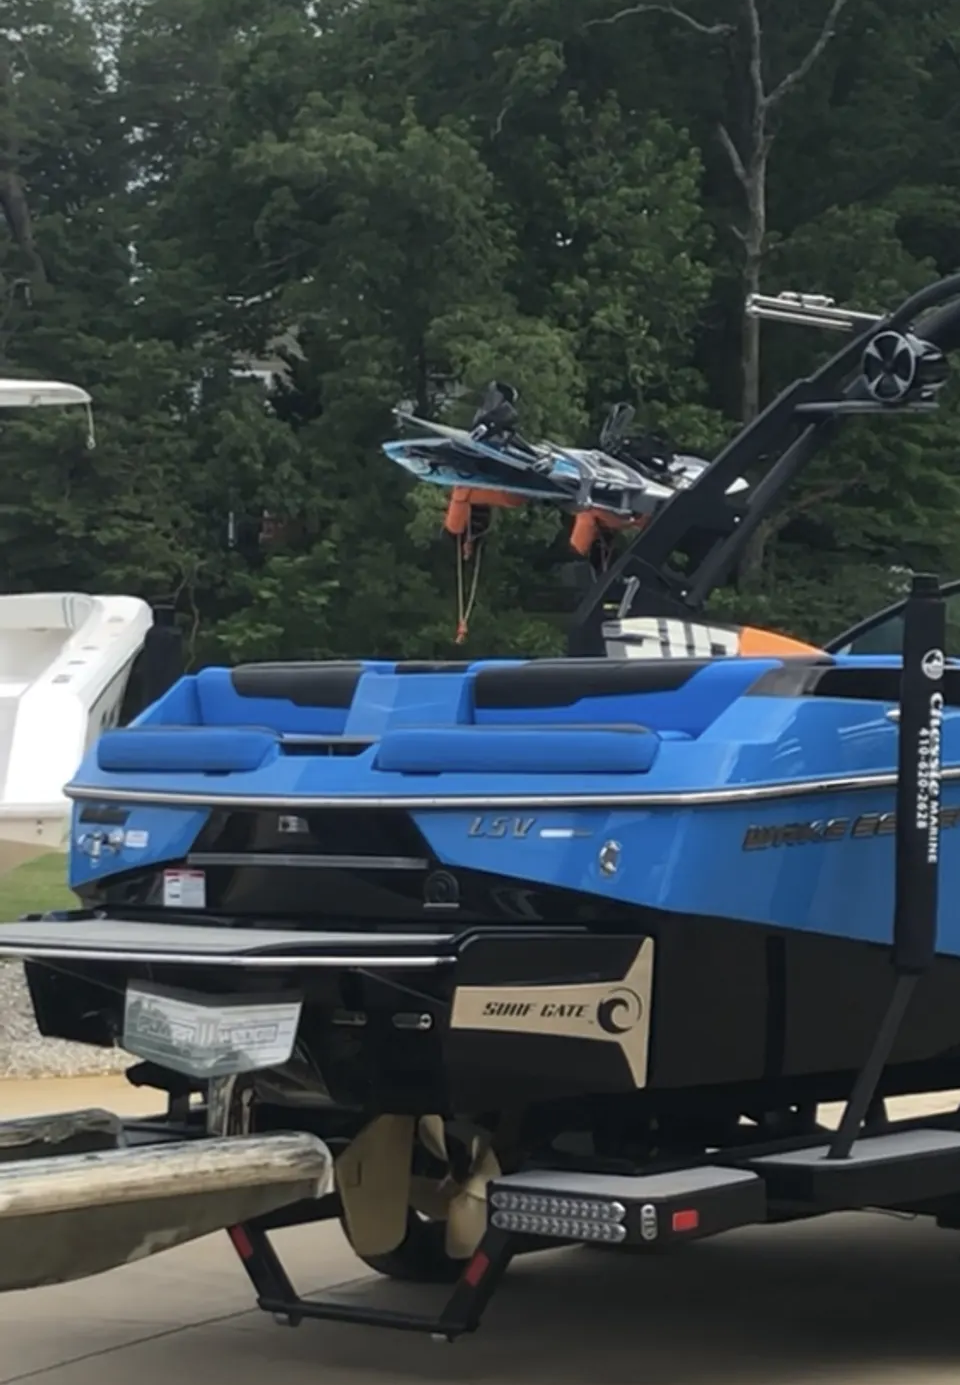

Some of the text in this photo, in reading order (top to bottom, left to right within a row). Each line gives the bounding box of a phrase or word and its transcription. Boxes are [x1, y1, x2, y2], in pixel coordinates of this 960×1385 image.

[916, 727, 930, 829] 410-620-2628
[468, 816, 536, 838] LSV
[927, 800, 939, 863] MARINE
[482, 1001, 590, 1018] SURF GATE
